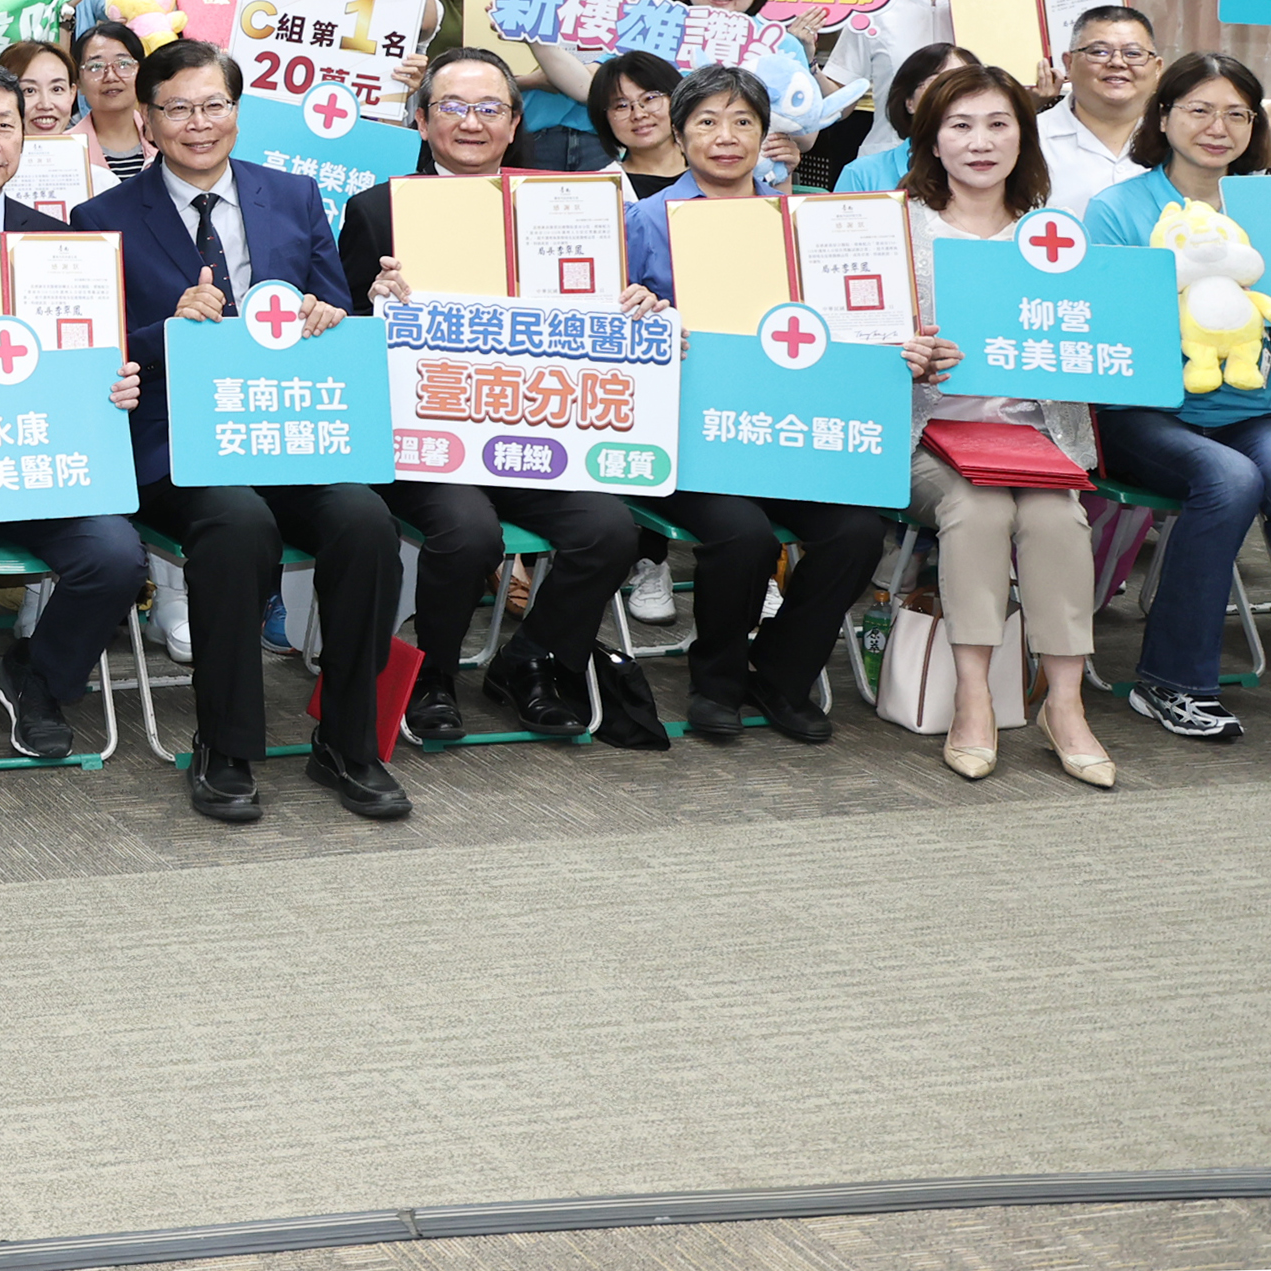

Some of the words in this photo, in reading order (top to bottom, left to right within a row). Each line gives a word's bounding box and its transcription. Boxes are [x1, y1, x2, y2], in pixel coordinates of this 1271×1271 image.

[262, 149, 377, 196] 高雄榮總
[384, 300, 673, 365] 高雄榮民總醫院
[1018, 296, 1092, 334] 柳營
[983, 336, 1134, 378] 奇美醫院
[212, 376, 349, 413] 臺南市立
[416, 357, 635, 431] 臺南分院
[214, 420, 351, 457] 安南醫院
[393, 434, 450, 467] 溫馨
[702, 407, 884, 456] 郭綜合醫院
[493, 440, 553, 474] 精緻
[596, 447, 656, 480] 優質
